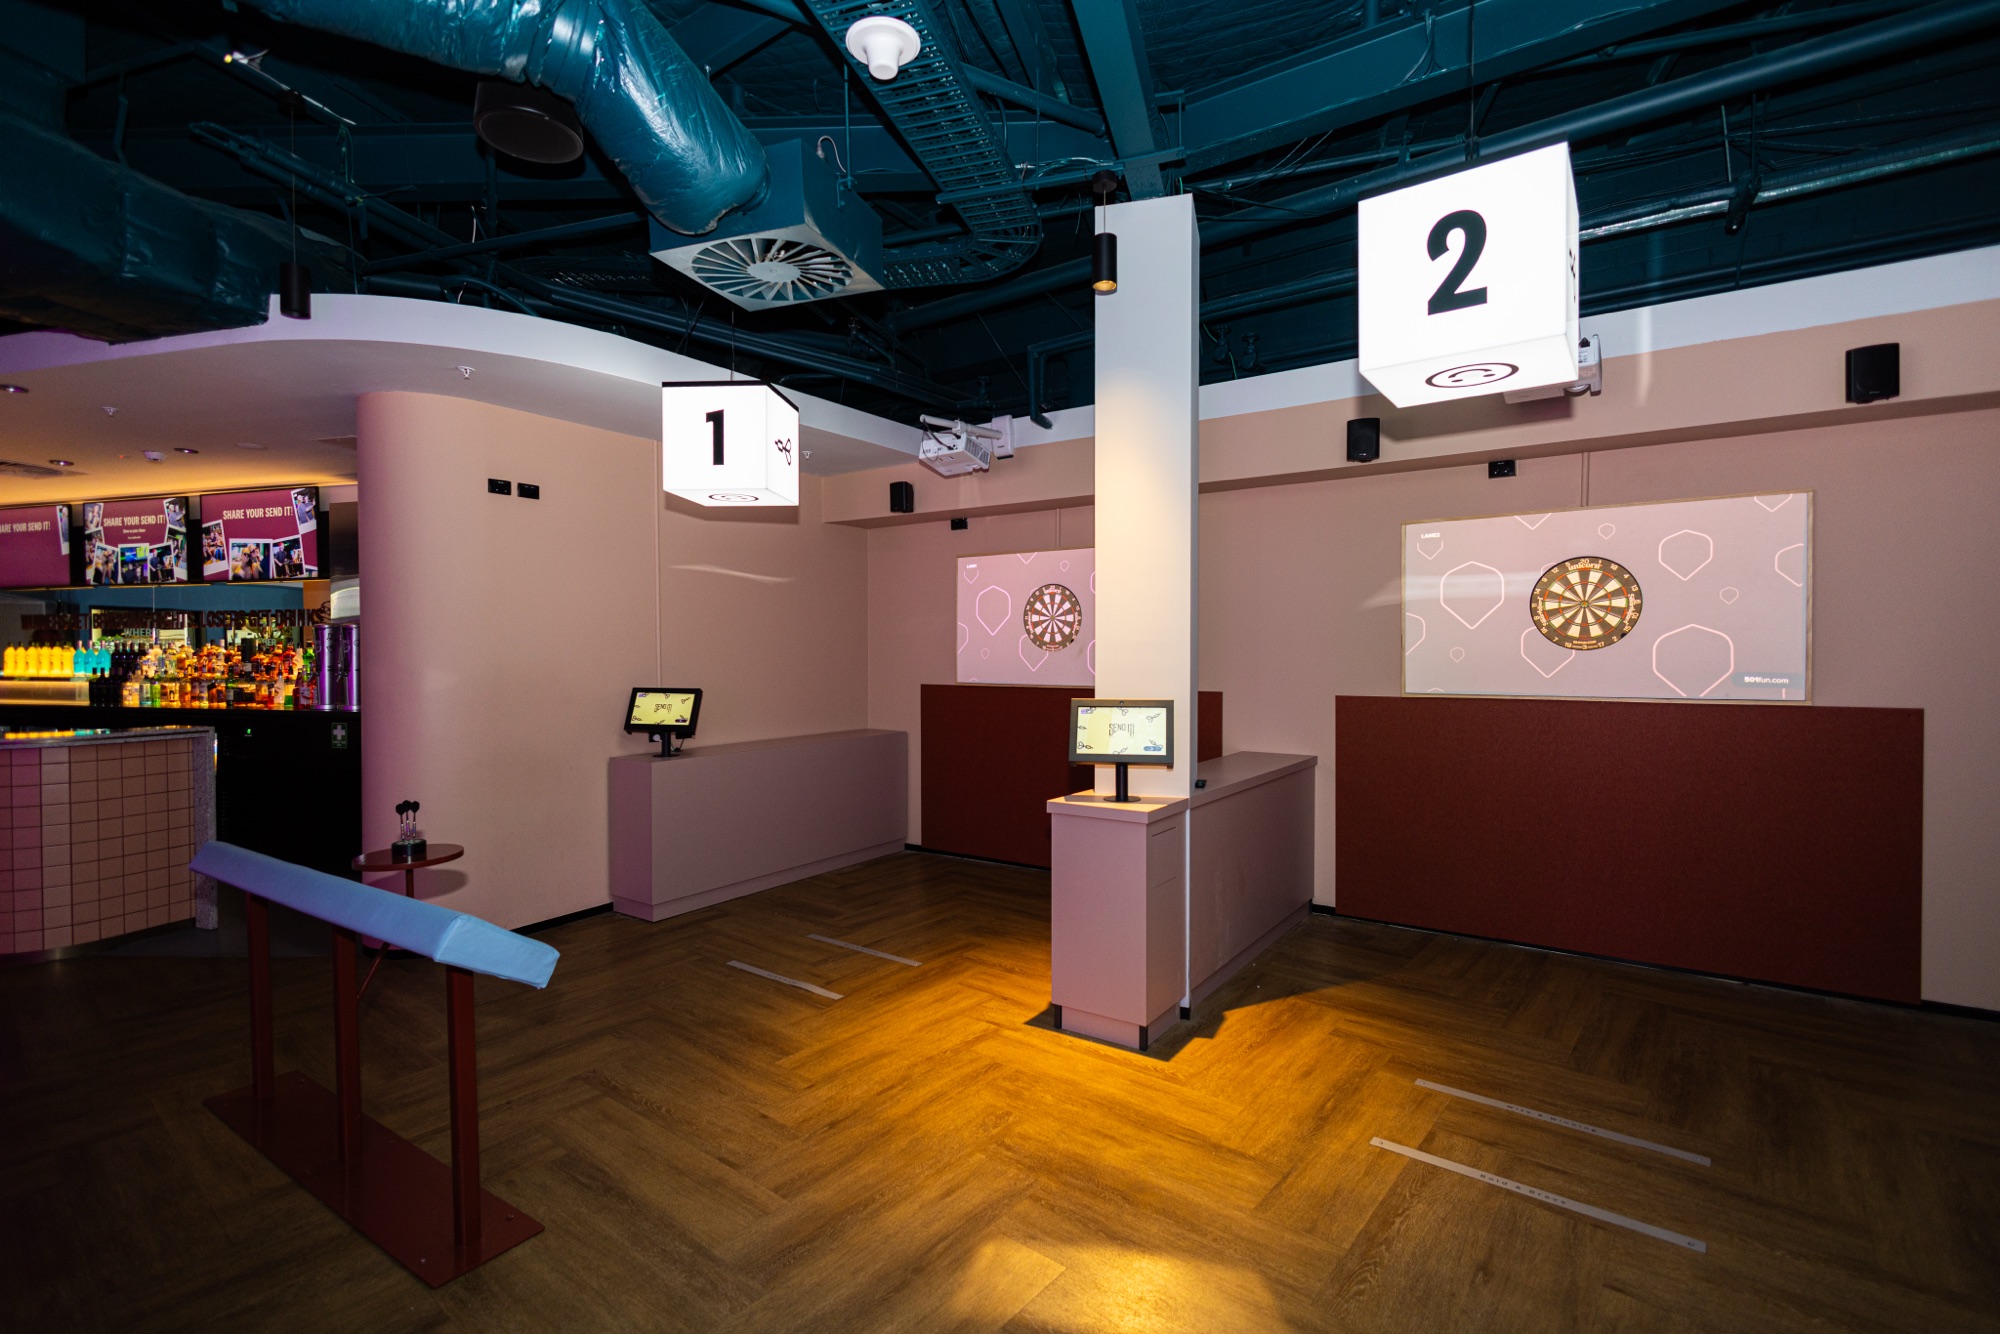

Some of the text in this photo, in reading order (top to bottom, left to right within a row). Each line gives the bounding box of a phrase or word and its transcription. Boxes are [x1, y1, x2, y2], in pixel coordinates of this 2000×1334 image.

[1427, 209, 1488, 316] 2
[705, 409, 725, 466] 1
[222, 506, 293, 520] SHARE YOUR SEND IT!
[12, 523, 27, 532] YOUR
[28, 521, 42, 531] SEND
[103, 514, 166, 527] SHARE YOUR SEND IT!
[249, 609, 272, 628] GET
[1743, 676, 1789, 684] 501fun.com
[1109, 723, 1126, 736] SEND
[1480, 1173, 1508, 1186] Bold
[1528, 1189, 1566, 1205] Brave
